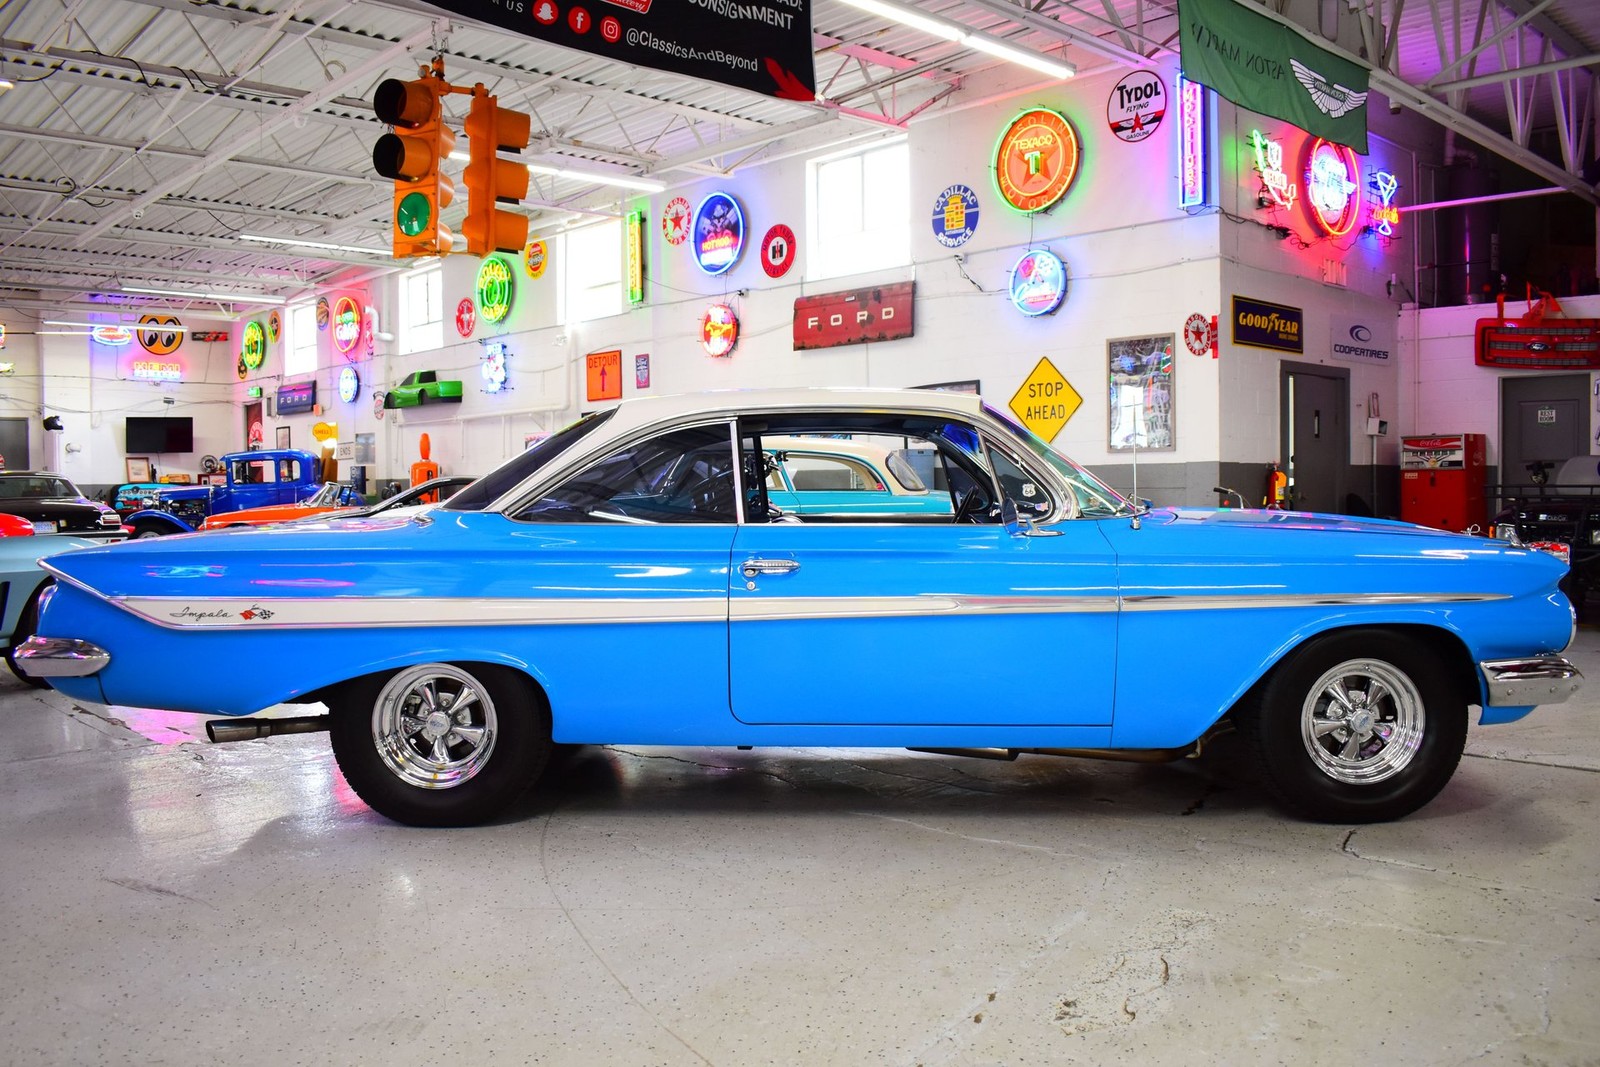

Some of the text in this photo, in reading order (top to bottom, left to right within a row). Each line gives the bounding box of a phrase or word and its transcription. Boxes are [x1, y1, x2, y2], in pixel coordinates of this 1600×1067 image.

[688, 0, 793, 30] ONSIGNMENT
[626, 27, 758, 72] @ClassicsAndBeyond
[1126, 101, 1149, 113] FLYING
[1014, 134, 1053, 151] TEXACO
[1126, 130, 1150, 140] GASOLINE
[934, 185, 977, 212] CADILLAC
[1001, 175, 1049, 210] MOTOR
[936, 226, 974, 247] SERVICE
[808, 307, 894, 329] FORD
[588, 355, 618, 368] DETOUR
[1028, 382, 1063, 398] STOP
[281, 394, 308, 404] FORD
[1026, 404, 1066, 420] AHEAD
[169, 606, 234, 622] Impala
